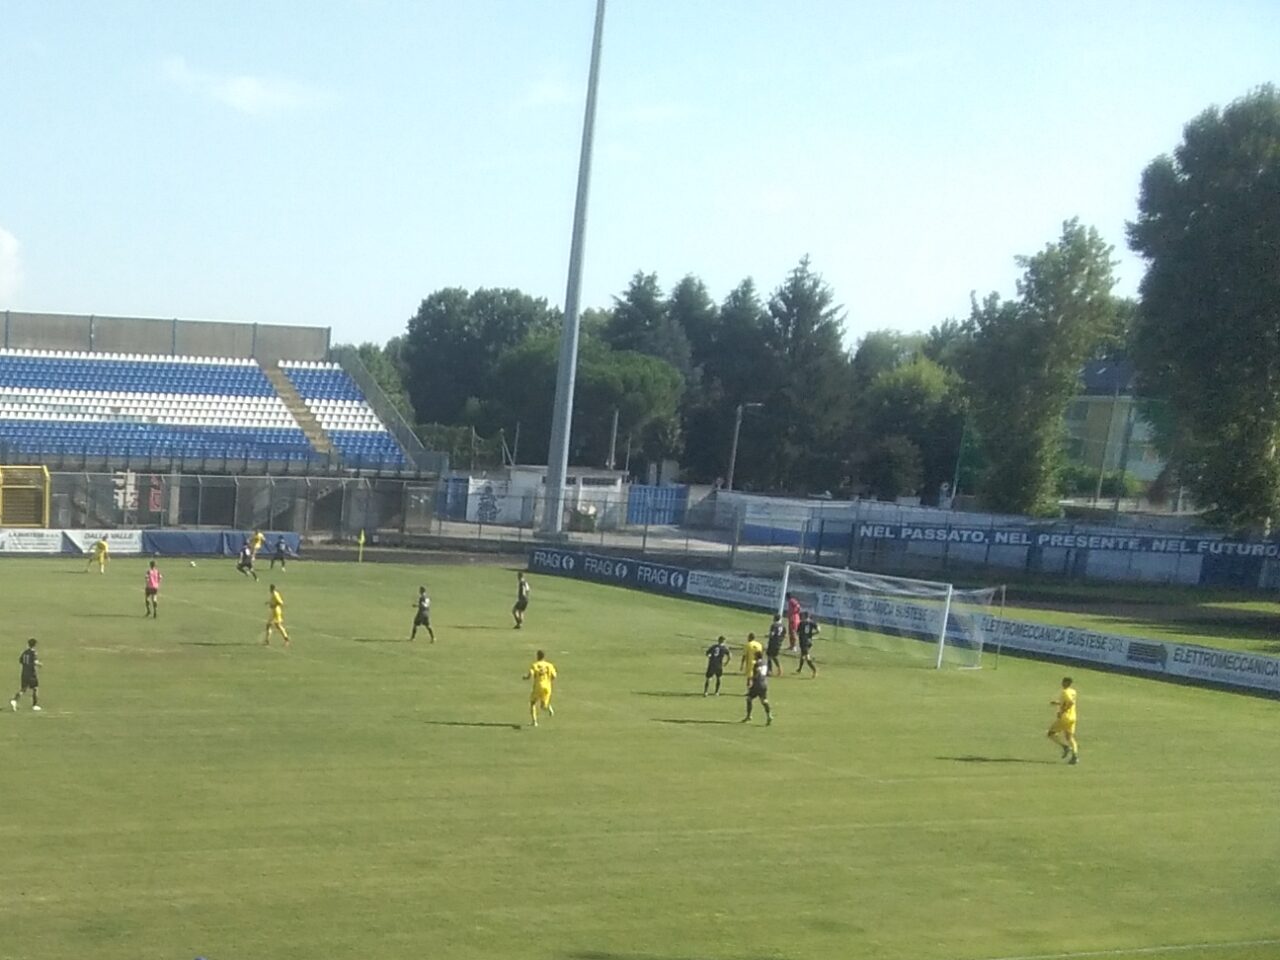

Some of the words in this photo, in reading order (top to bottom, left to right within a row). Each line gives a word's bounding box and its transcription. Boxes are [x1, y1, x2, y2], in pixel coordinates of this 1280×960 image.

[859, 525, 895, 538] NEL
[900, 527, 990, 544] PASSATO,
[994, 531, 1032, 545] NEL
[1038, 533, 1147, 551] PRESENTE,
[1151, 538, 1191, 552] NEL
[533, 551, 561, 568] FRAGI
[584, 557, 613, 576] FRAGI
[637, 565, 669, 585] FRAGI
[1066, 630, 1109, 650] BUSTESE
